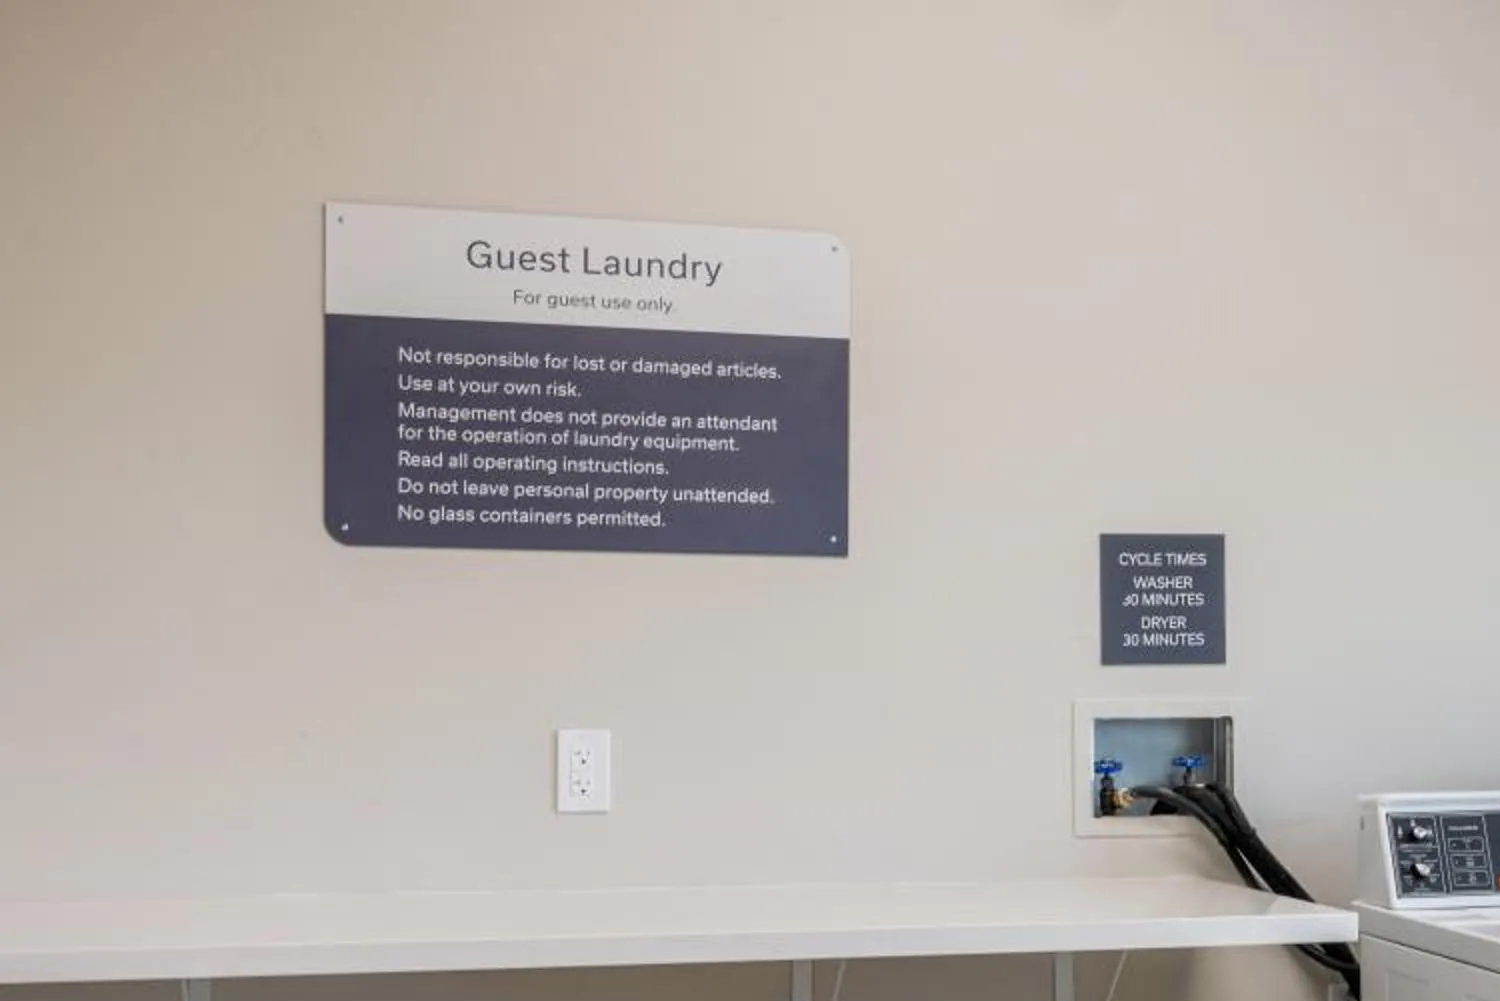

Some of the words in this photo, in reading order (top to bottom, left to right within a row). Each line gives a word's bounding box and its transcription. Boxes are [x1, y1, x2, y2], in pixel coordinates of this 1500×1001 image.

[466, 238, 571, 274] Guest
[583, 246, 722, 287] Laundry
[513, 288, 542, 306] For
[546, 293, 596, 310] guest
[601, 296, 632, 311] use
[636, 295, 677, 316] only.
[398, 346, 432, 364] Not
[436, 350, 540, 369] responsible
[543, 352, 569, 370] for
[573, 354, 606, 372] lost
[609, 359, 629, 373] or
[631, 356, 713, 379] damaged
[716, 361, 782, 381] articles.
[398, 373, 433, 392] Use
[437, 376, 455, 394] at
[459, 379, 500, 397] your
[503, 381, 542, 397] own
[545, 380, 582, 398] risk.
[397, 402, 517, 423] Management
[520, 406, 565, 424] does
[568, 409, 598, 426] not
[600, 411, 668, 429] provide
[671, 415, 692, 429] an
[696, 415, 778, 432] attendant
[398, 423, 423, 441] for
[427, 425, 457, 443] the
[461, 427, 547, 445] operation
[551, 428, 570, 446] of
[573, 429, 640, 452] laundry
[642, 433, 740, 453] equipment.
[398, 449, 443, 469] Read
[448, 451, 469, 469] all
[473, 454, 558, 476] operating
[562, 454, 669, 476] instructions.
[397, 476, 424, 495] Do
[428, 479, 459, 496] not
[463, 478, 510, 497] leave
[513, 482, 589, 500] personal
[593, 485, 669, 505] property
[672, 487, 775, 505] unattended.
[397, 504, 425, 522] No
[428, 505, 475, 525] glass
[479, 507, 573, 525] containers
[576, 509, 666, 529] permitted.
[1119, 551, 1162, 566] CYCLE
[1165, 552, 1207, 566] TIMES
[1133, 575, 1193, 590] WASHER
[1141, 592, 1205, 607] MINUTES
[1140, 615, 1187, 630] DRYER
[1123, 633, 1140, 647] 30
[1142, 632, 1205, 646] MINUTES
